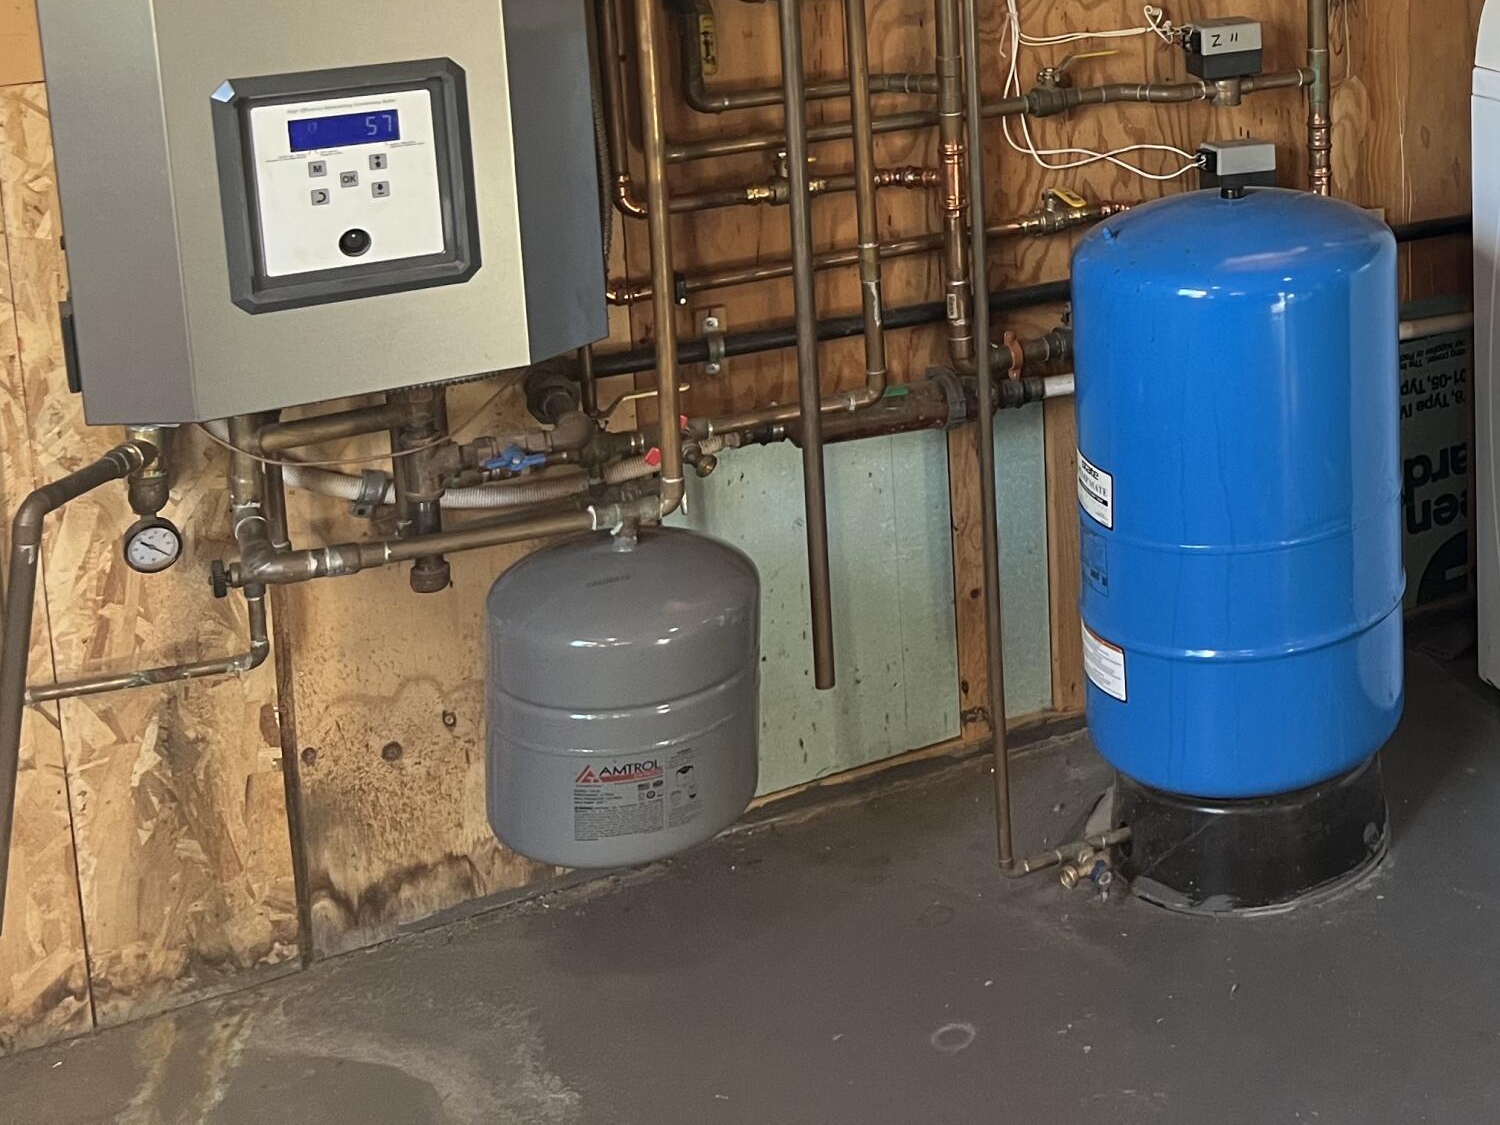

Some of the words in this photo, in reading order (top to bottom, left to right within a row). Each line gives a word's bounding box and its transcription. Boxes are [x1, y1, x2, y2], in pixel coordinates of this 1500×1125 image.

[365, 114, 393, 136] 57
[342, 174, 357, 184] OK
[599, 759, 658, 776] AMTROL
